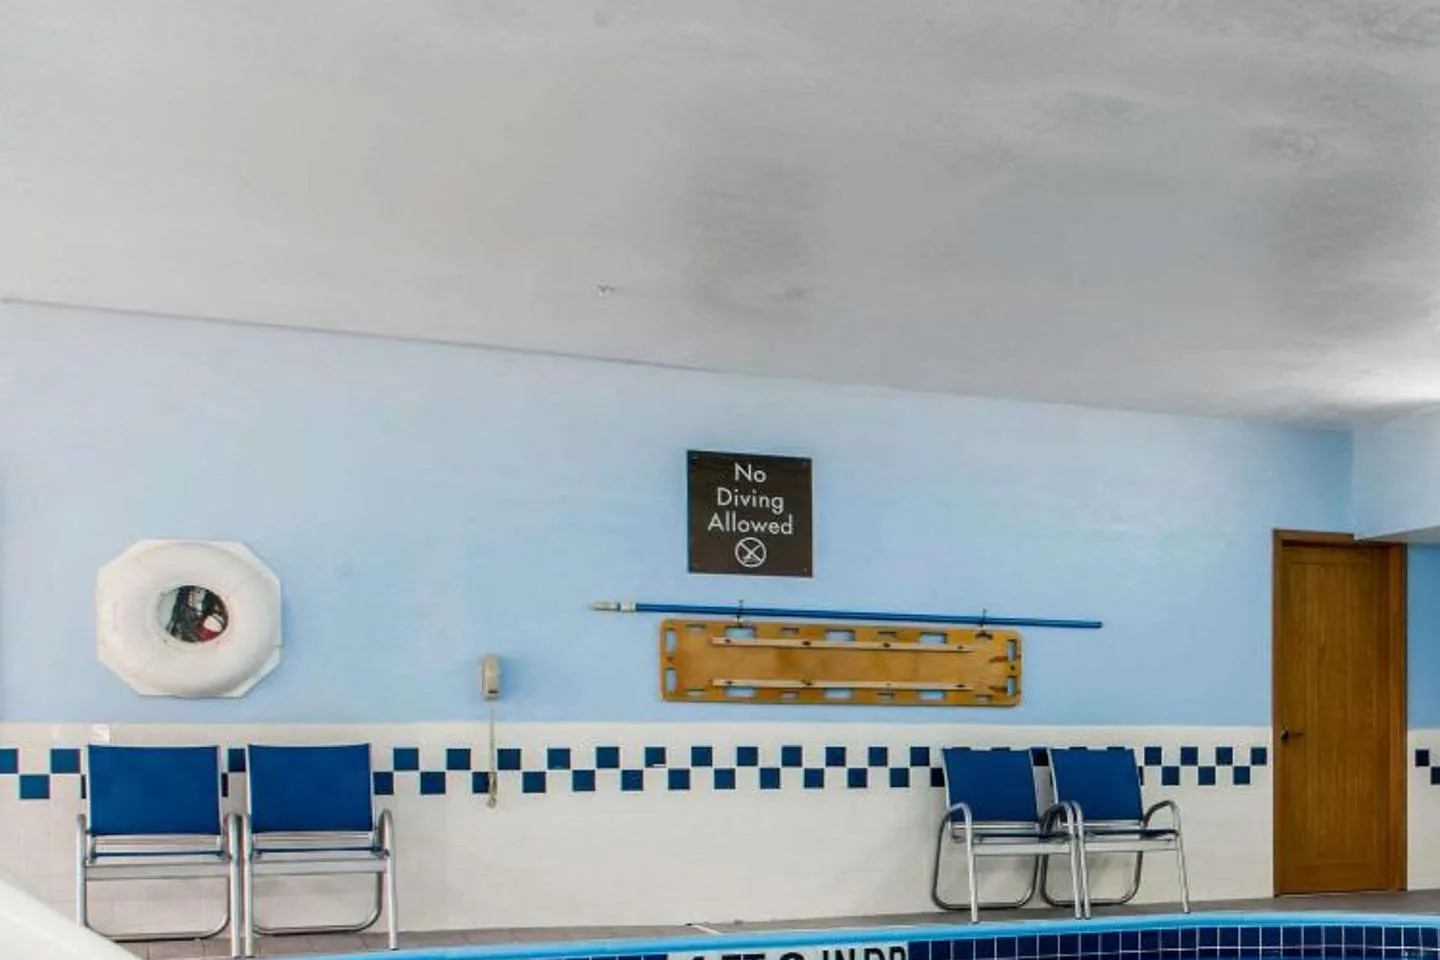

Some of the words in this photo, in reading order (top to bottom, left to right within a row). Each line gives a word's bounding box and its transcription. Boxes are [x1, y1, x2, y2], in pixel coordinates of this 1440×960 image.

[734, 462, 767, 482] No
[717, 487, 784, 515] Diving
[707, 510, 793, 534] Allowed
